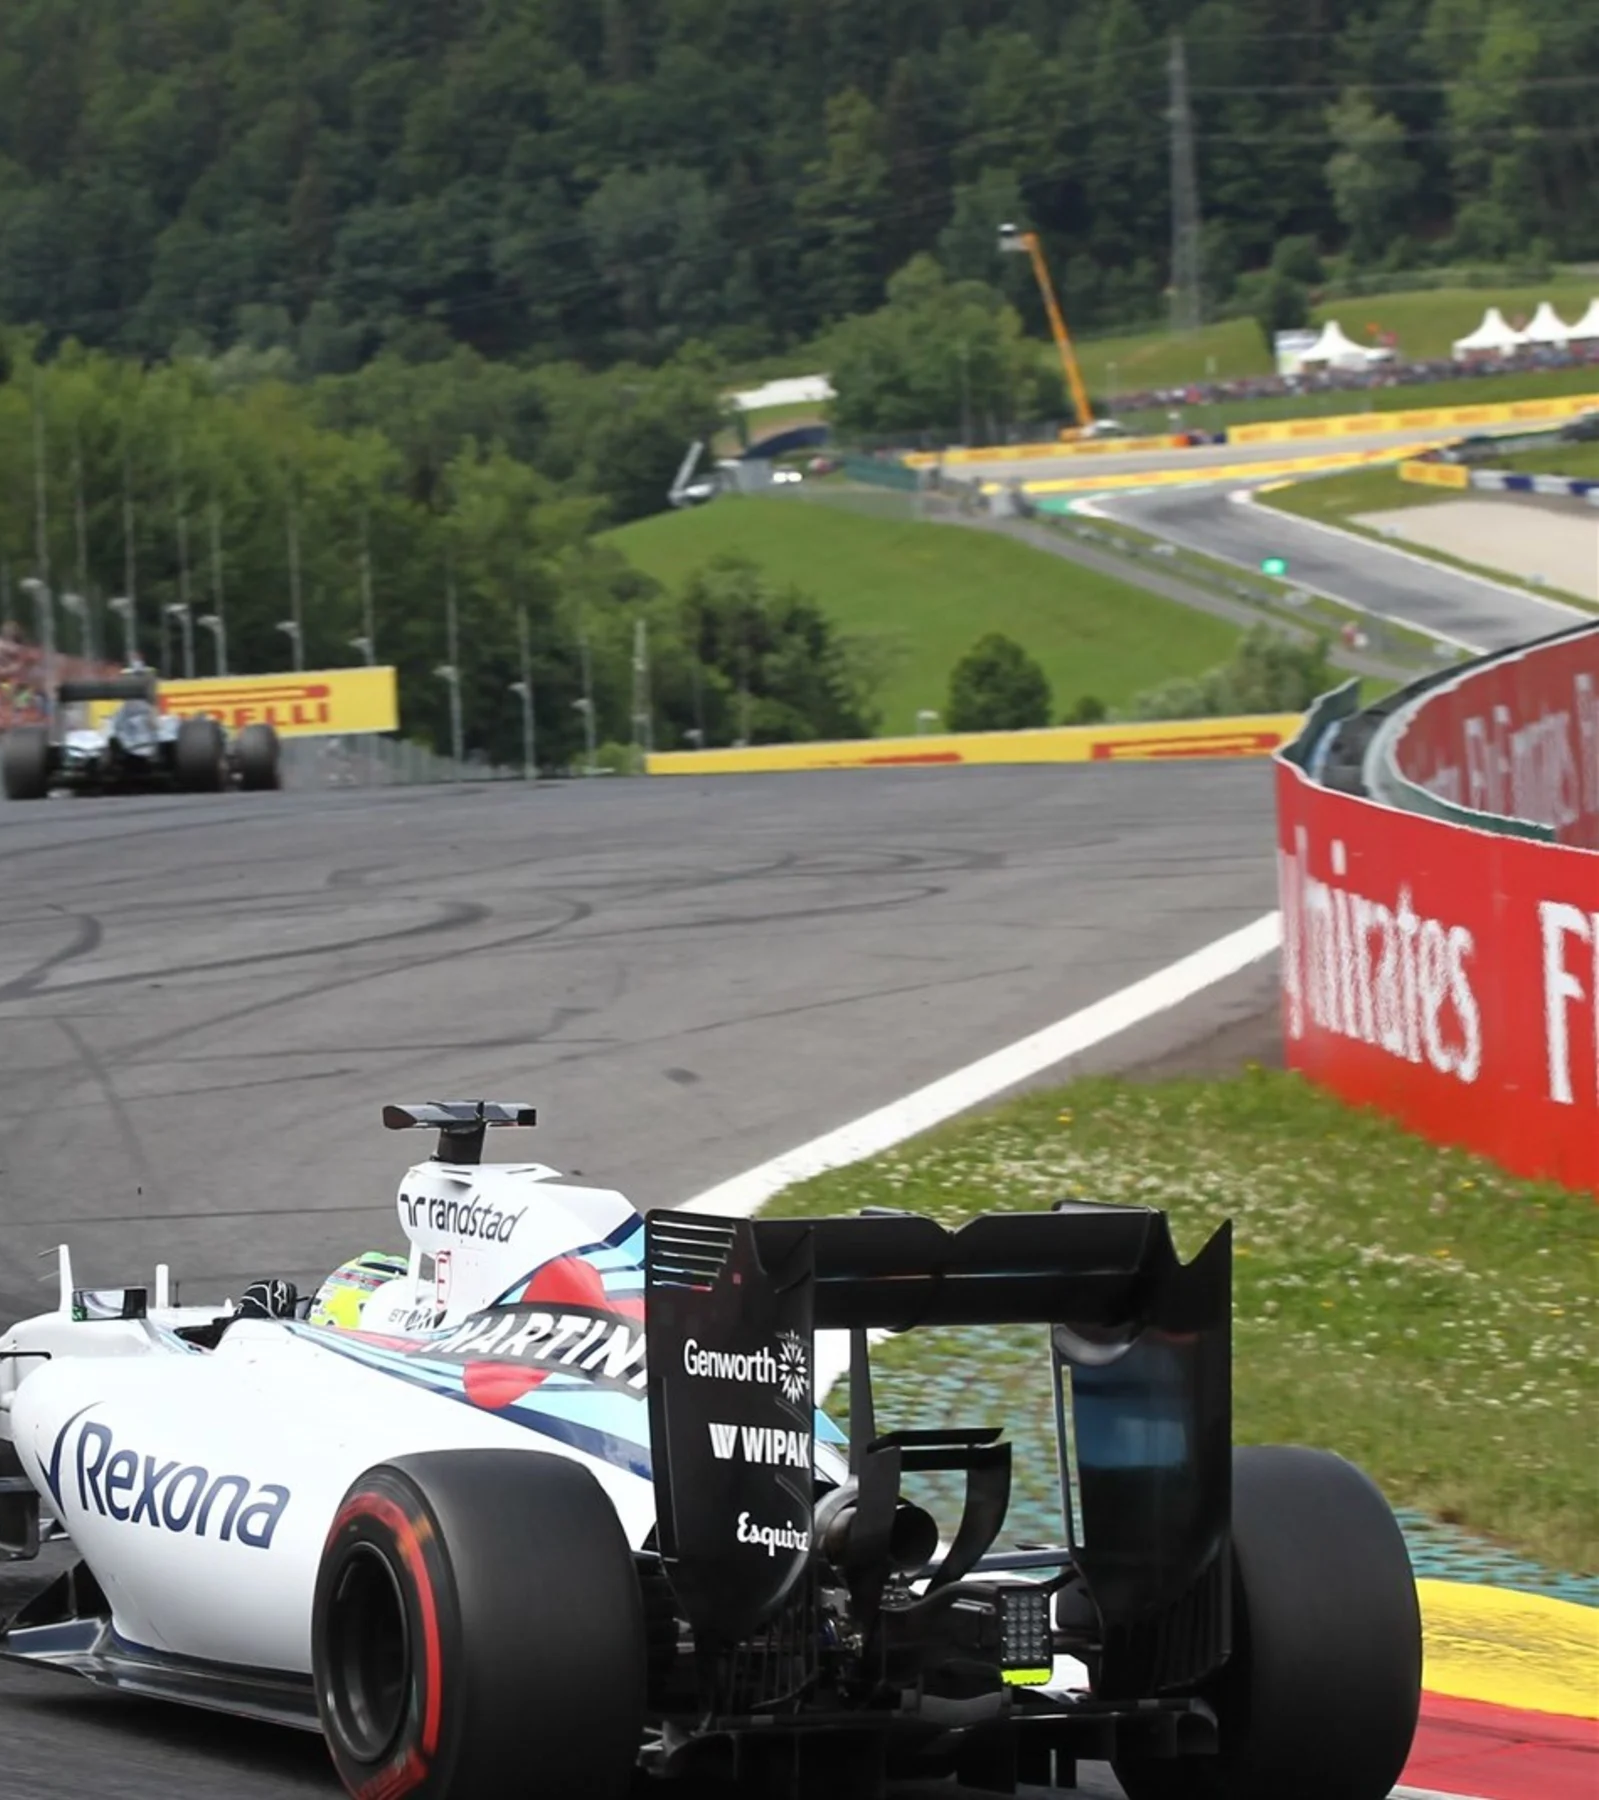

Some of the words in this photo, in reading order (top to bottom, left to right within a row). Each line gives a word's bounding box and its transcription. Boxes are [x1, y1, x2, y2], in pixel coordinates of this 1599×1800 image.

[429, 1194, 529, 1243] randstad
[683, 1338, 778, 1384] Genworth
[741, 1425, 811, 1469] WIPAK
[76, 1421, 292, 1549] Rexona
[736, 1511, 810, 1557] Esquire
